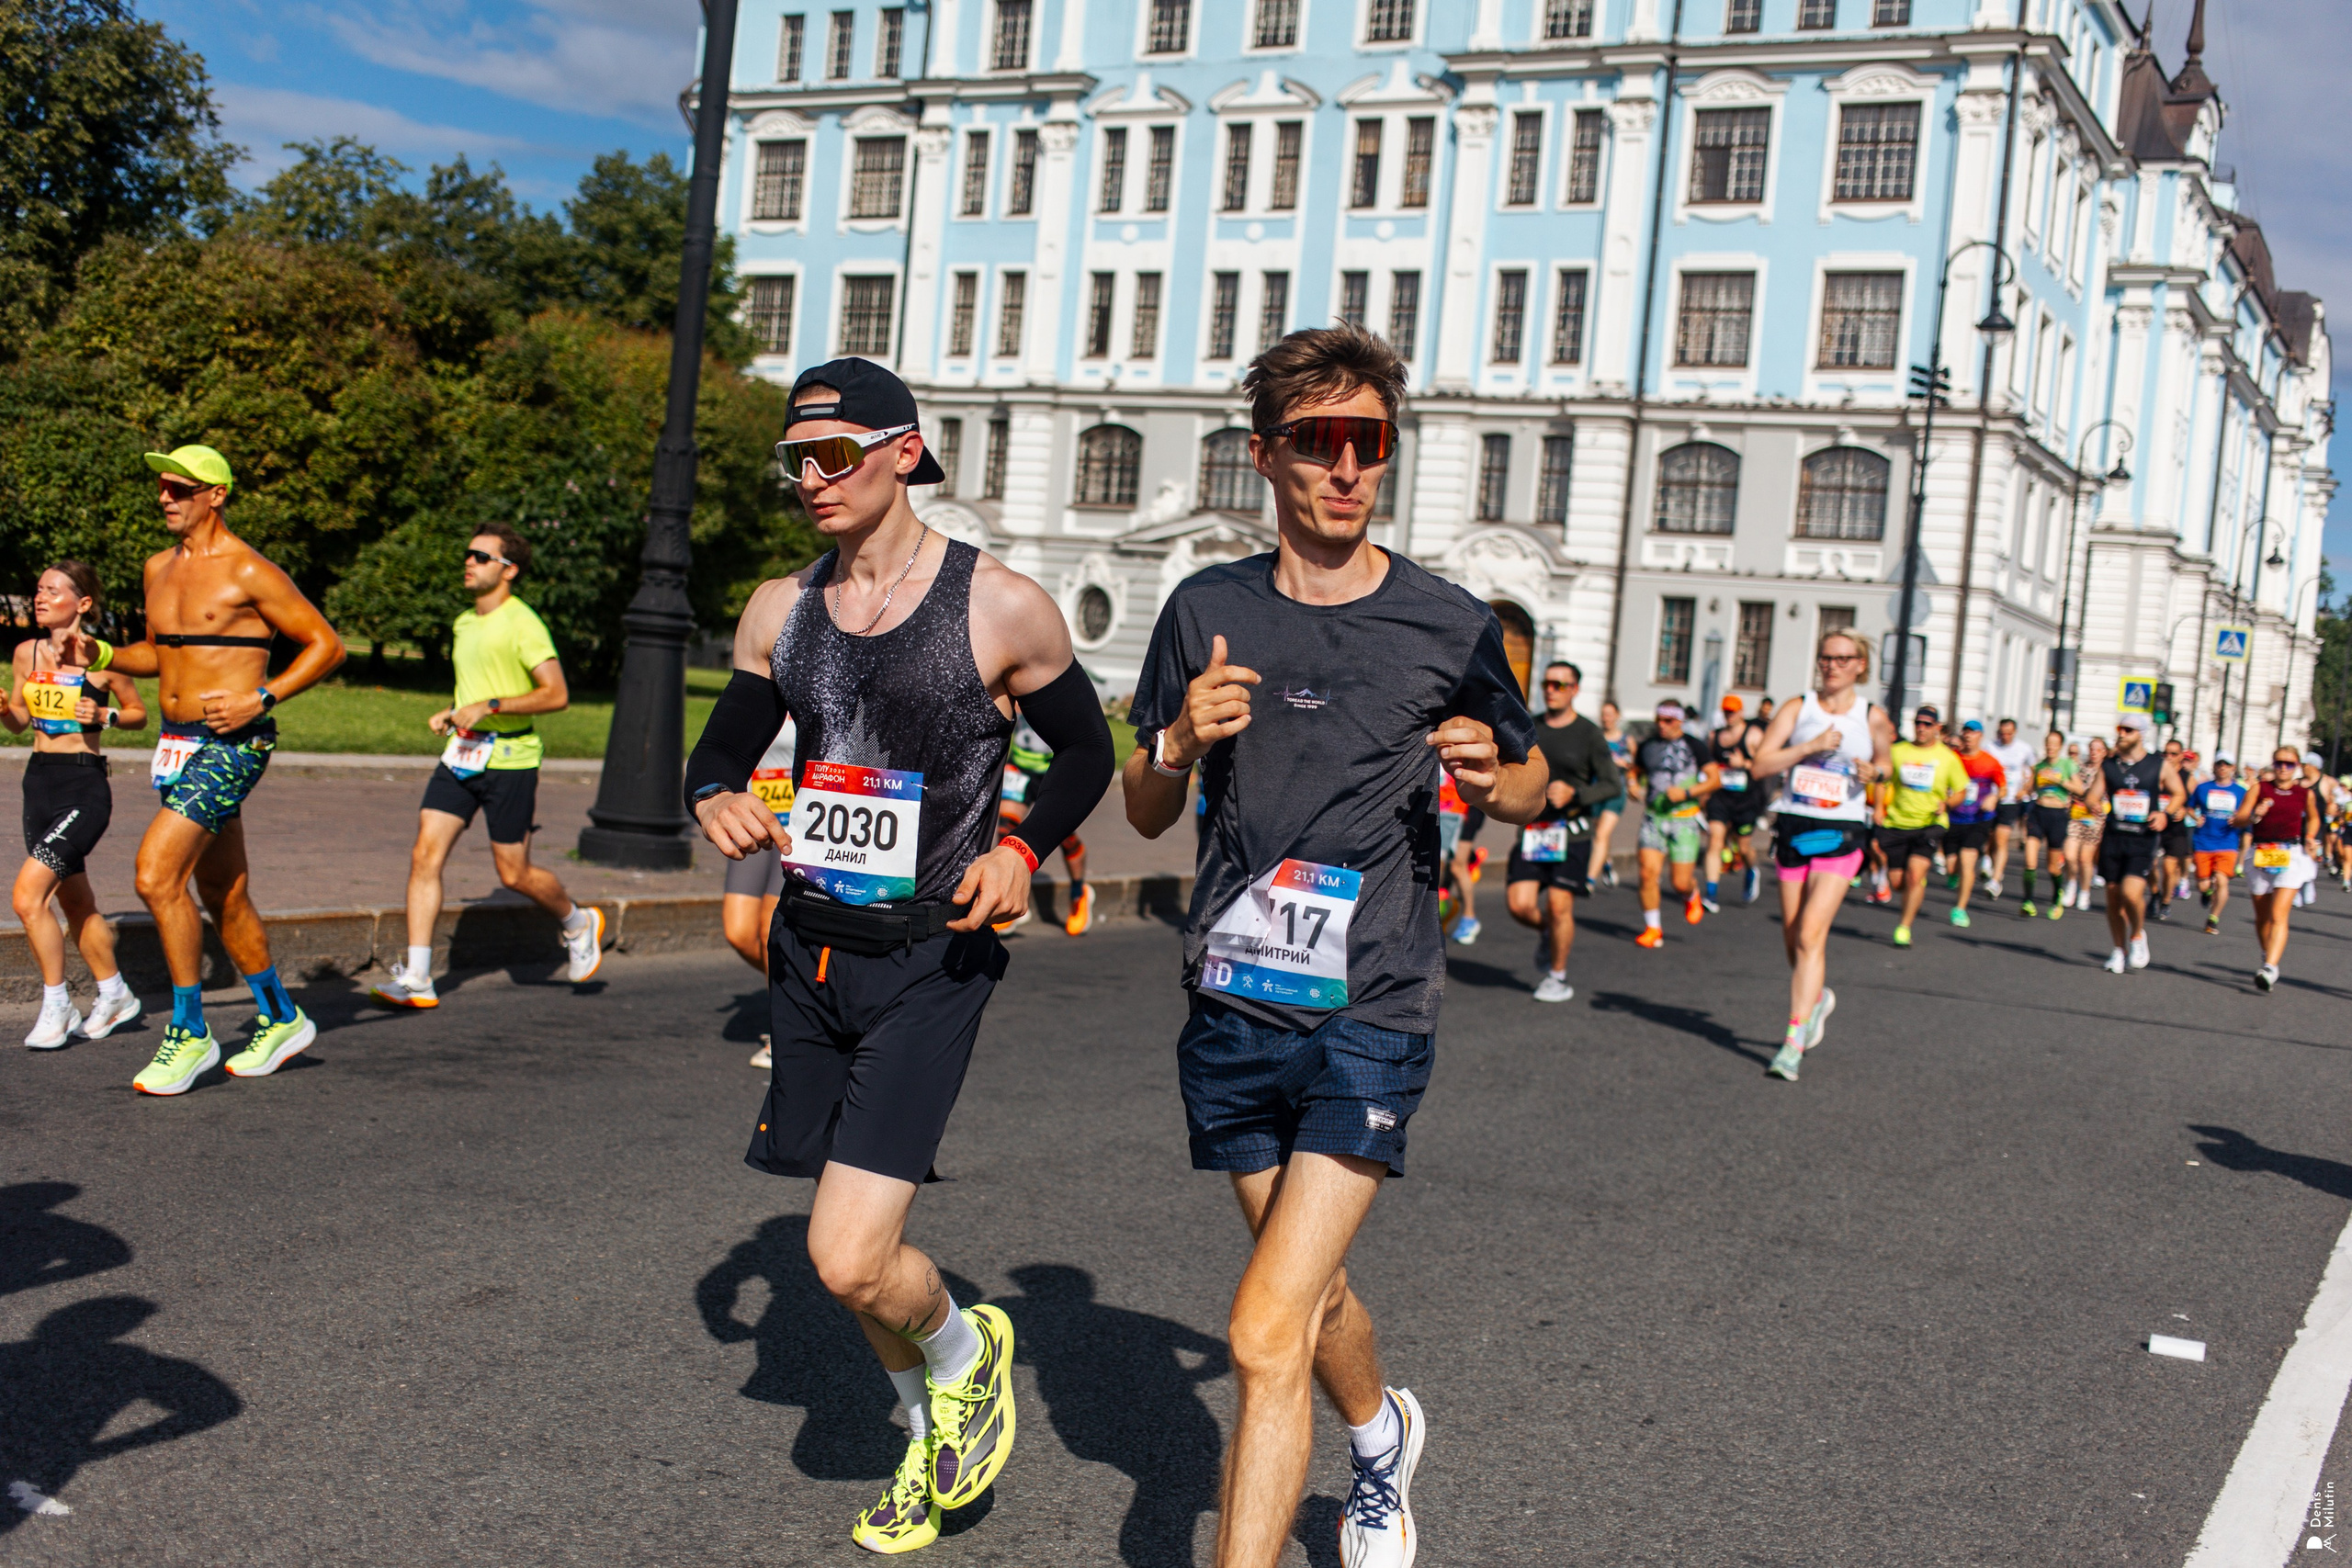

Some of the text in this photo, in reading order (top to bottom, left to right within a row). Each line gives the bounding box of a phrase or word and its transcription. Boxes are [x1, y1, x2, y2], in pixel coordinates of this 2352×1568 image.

[33, 689, 63, 709] 312
[814, 763, 830, 773] ПОЛУ
[811, 772, 845, 784] МАРАФОН
[863, 775, 902, 791] 21,1 КМ
[804, 800, 899, 852] 2030
[1002, 838, 1027, 855] 2030
[824, 848, 867, 865] ДАНИЛ
[1294, 869, 1340, 888] 21,1 КМ
